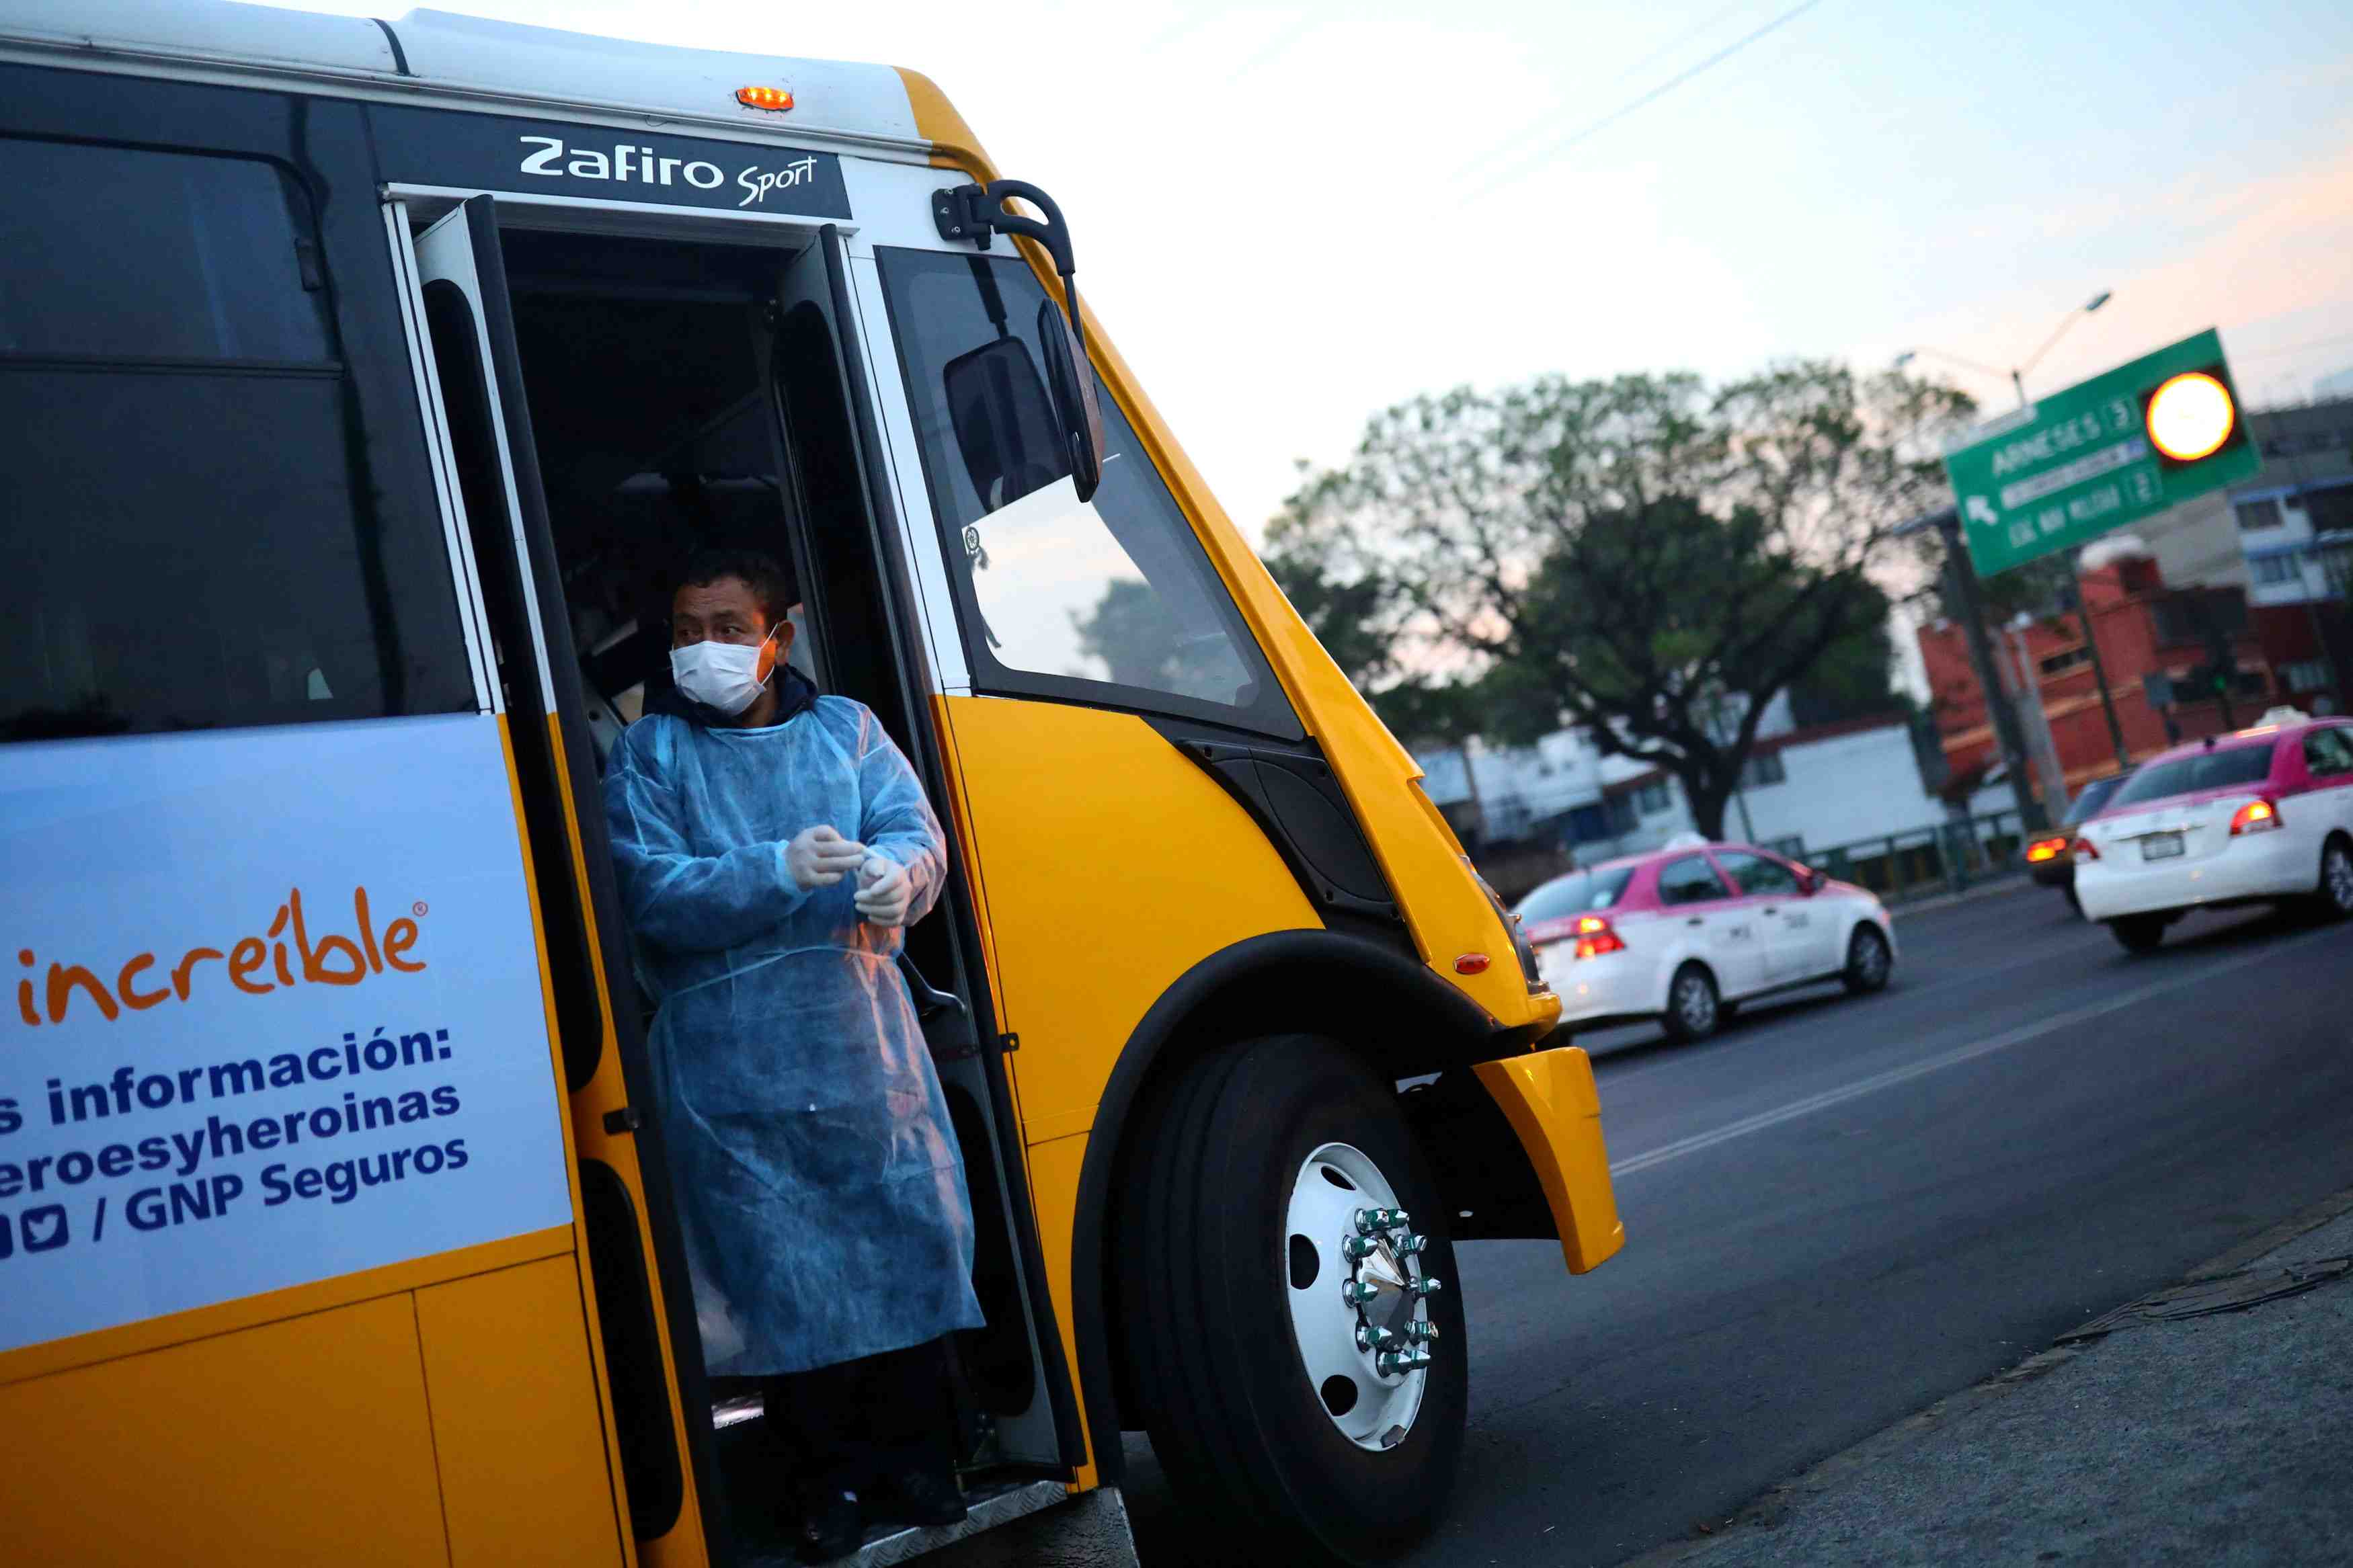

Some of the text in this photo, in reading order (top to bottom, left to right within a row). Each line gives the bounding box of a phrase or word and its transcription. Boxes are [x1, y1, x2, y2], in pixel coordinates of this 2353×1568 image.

[520, 136, 817, 207] Zafiro Sport
[18, 886, 426, 1025] increíble
[46, 1026, 452, 1126] información:
[0, 1086, 461, 1198] eroesyheroinas
[125, 1174, 243, 1232] GNP
[260, 1139, 469, 1206] Seguros
